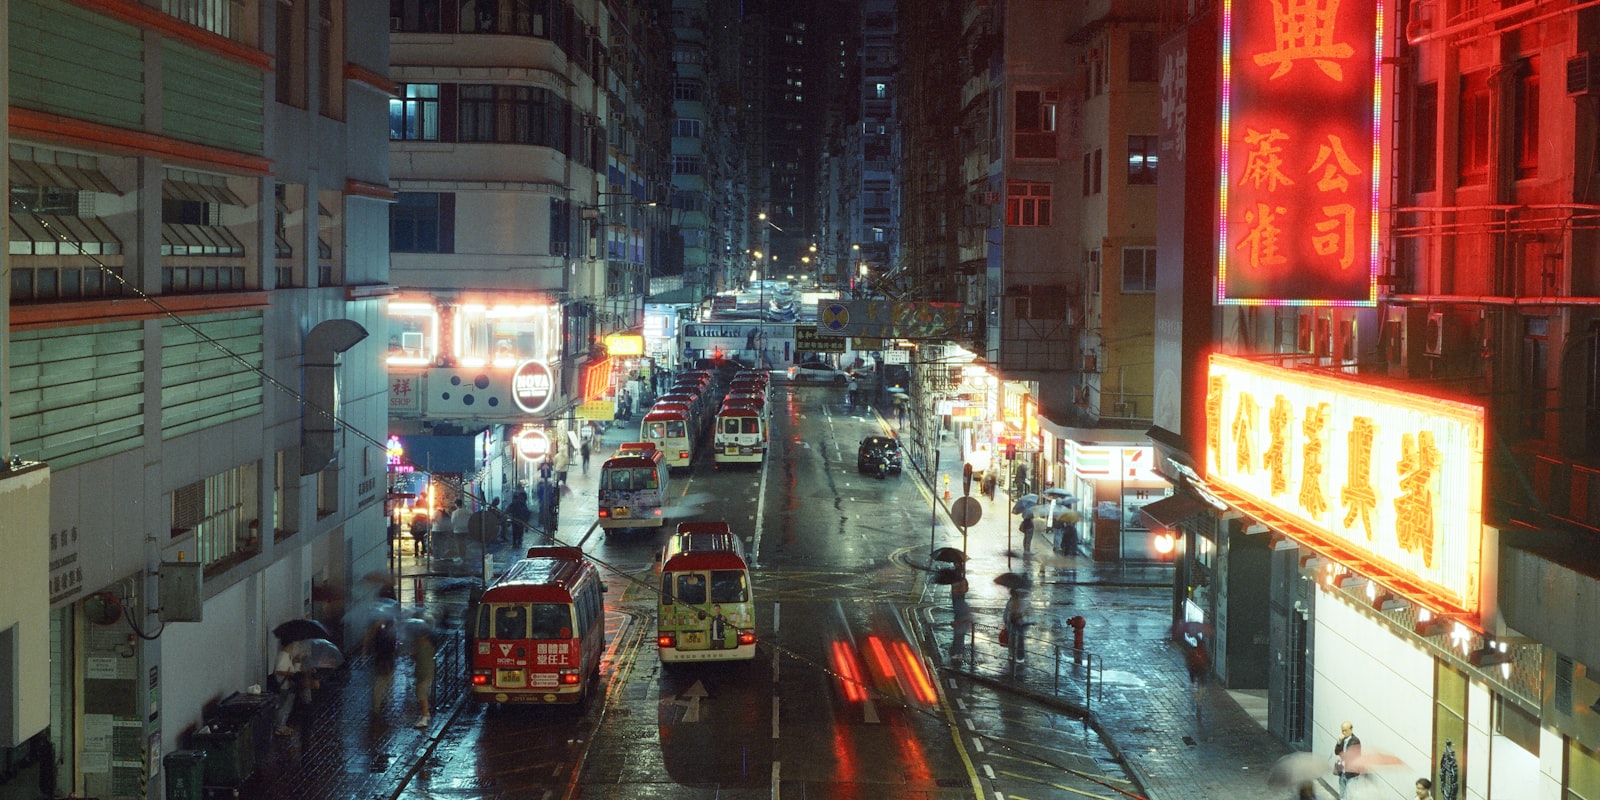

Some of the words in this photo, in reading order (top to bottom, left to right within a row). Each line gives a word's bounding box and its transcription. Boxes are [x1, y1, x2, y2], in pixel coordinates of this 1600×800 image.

[392, 378, 412, 396] 祥
[517, 374, 550, 388] NOVA
[390, 397, 412, 406] SHOP
[536, 654, 569, 666] 堂任上
